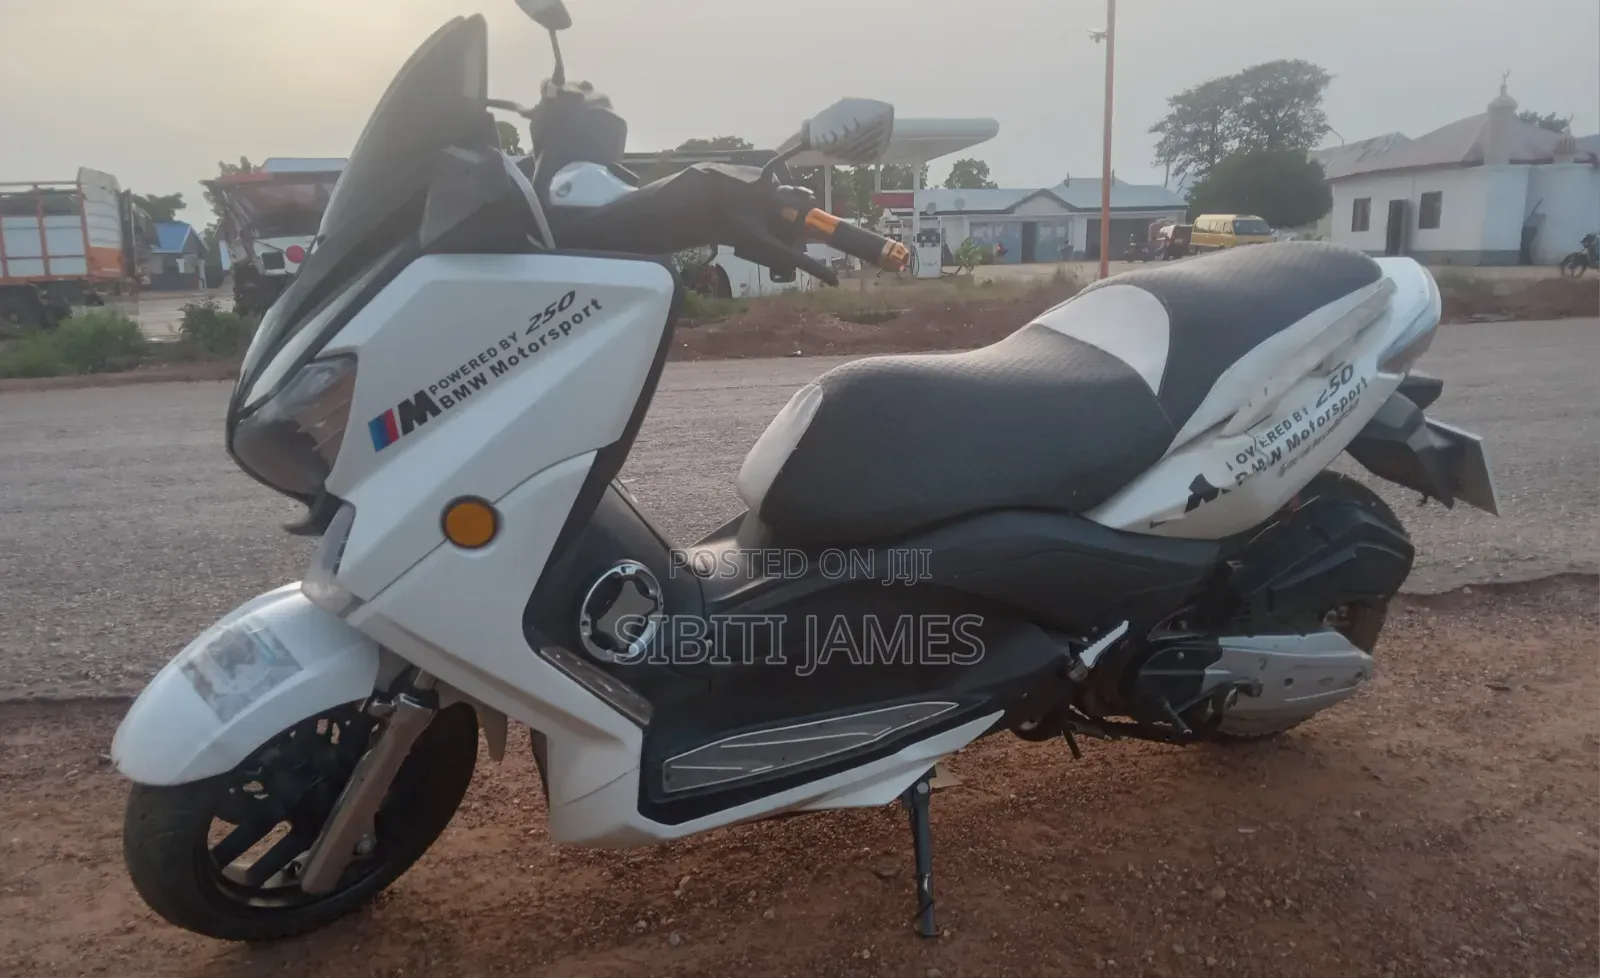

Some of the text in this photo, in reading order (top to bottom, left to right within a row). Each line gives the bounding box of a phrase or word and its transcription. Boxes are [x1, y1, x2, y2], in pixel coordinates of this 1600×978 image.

[428, 290, 576, 396] POWERED BY 250
[438, 298, 603, 410] BMW Motorsport
[397, 389, 442, 436] M
[1225, 418, 1293, 472] OWERED
[1285, 376, 1368, 453] Motorsport
